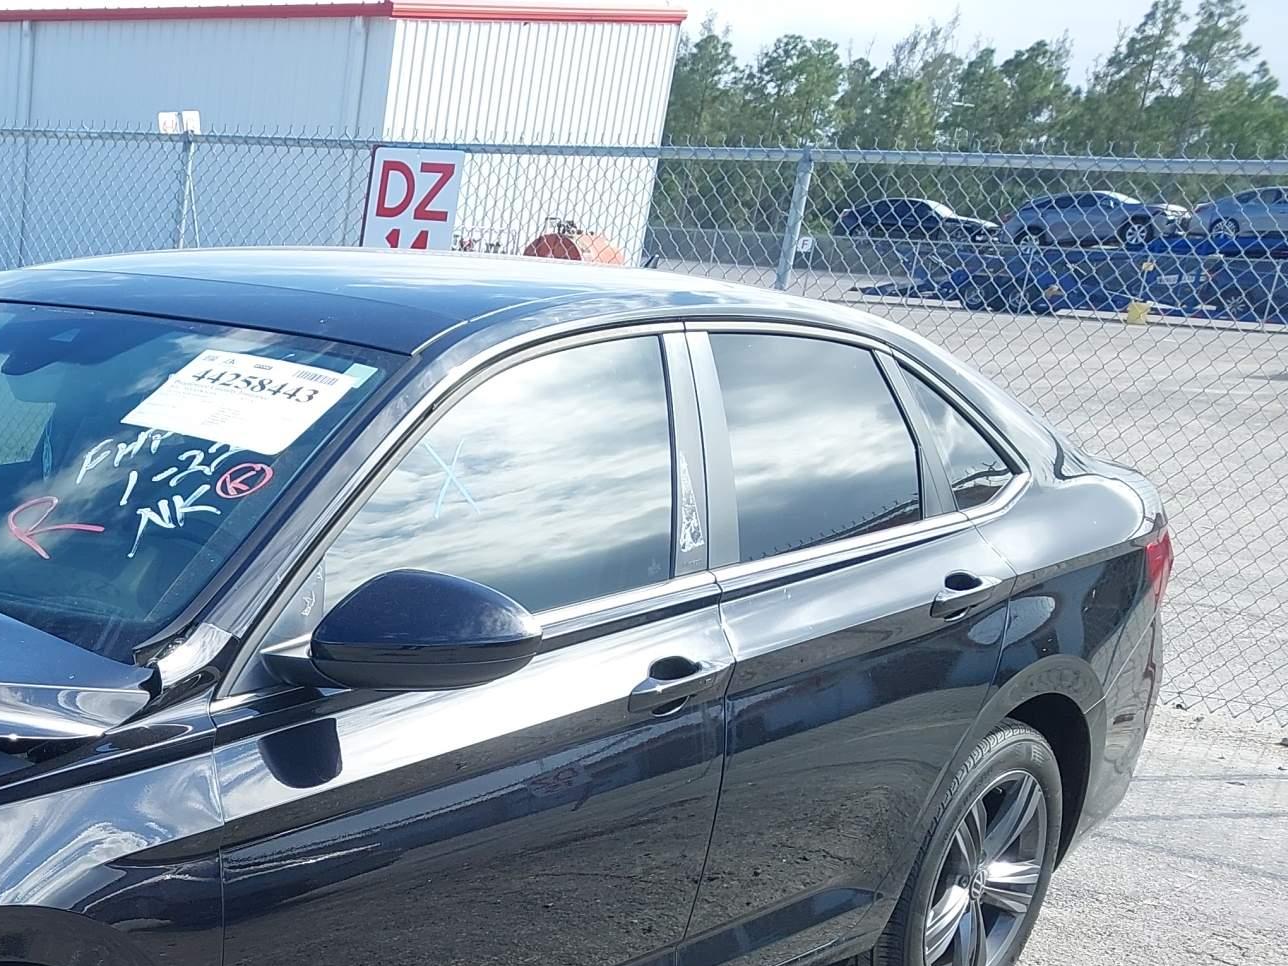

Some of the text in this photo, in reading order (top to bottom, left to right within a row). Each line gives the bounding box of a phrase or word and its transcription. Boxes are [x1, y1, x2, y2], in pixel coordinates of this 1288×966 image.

[375, 159, 456, 222] DZ
[191, 368, 320, 404] 44258443
[127, 484, 222, 559] NK
